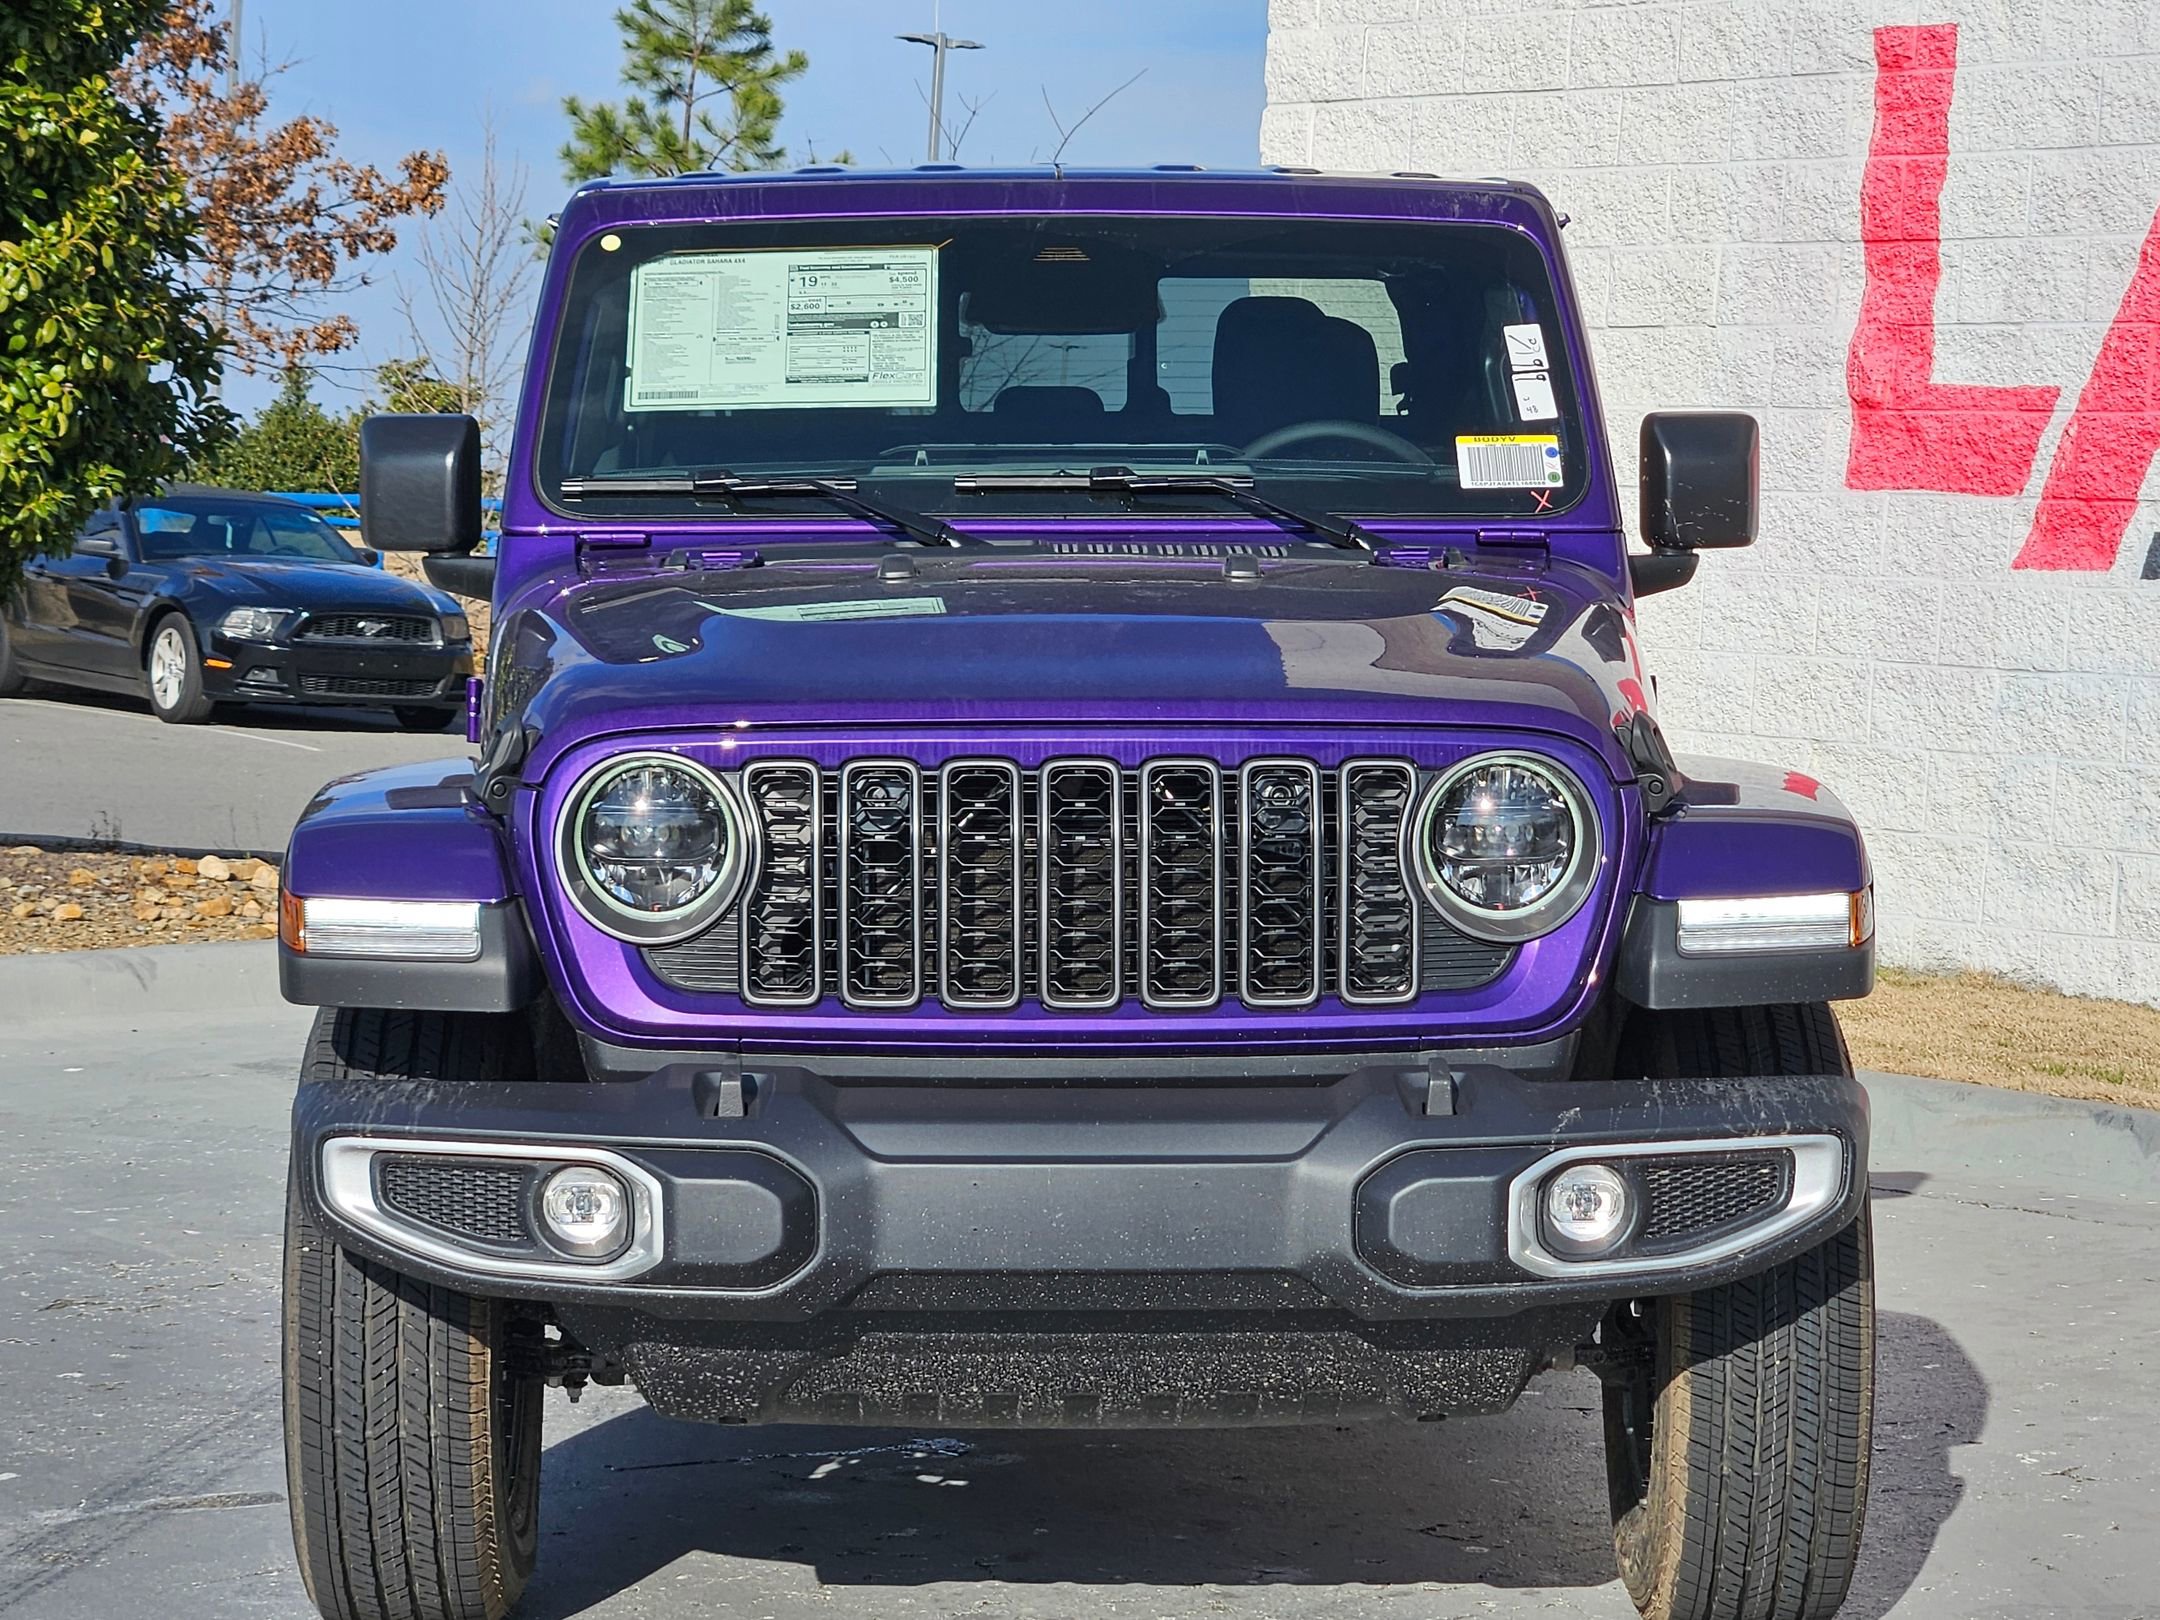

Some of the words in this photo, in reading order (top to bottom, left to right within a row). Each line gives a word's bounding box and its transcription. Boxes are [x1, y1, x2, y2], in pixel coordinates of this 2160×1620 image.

[669, 258, 705, 266] GLADIATOR
[799, 275, 818, 287] 19
[889, 275, 919, 284] $4,500
[790, 303, 820, 311] $2,600
[872, 372, 923, 380] FlexCare
